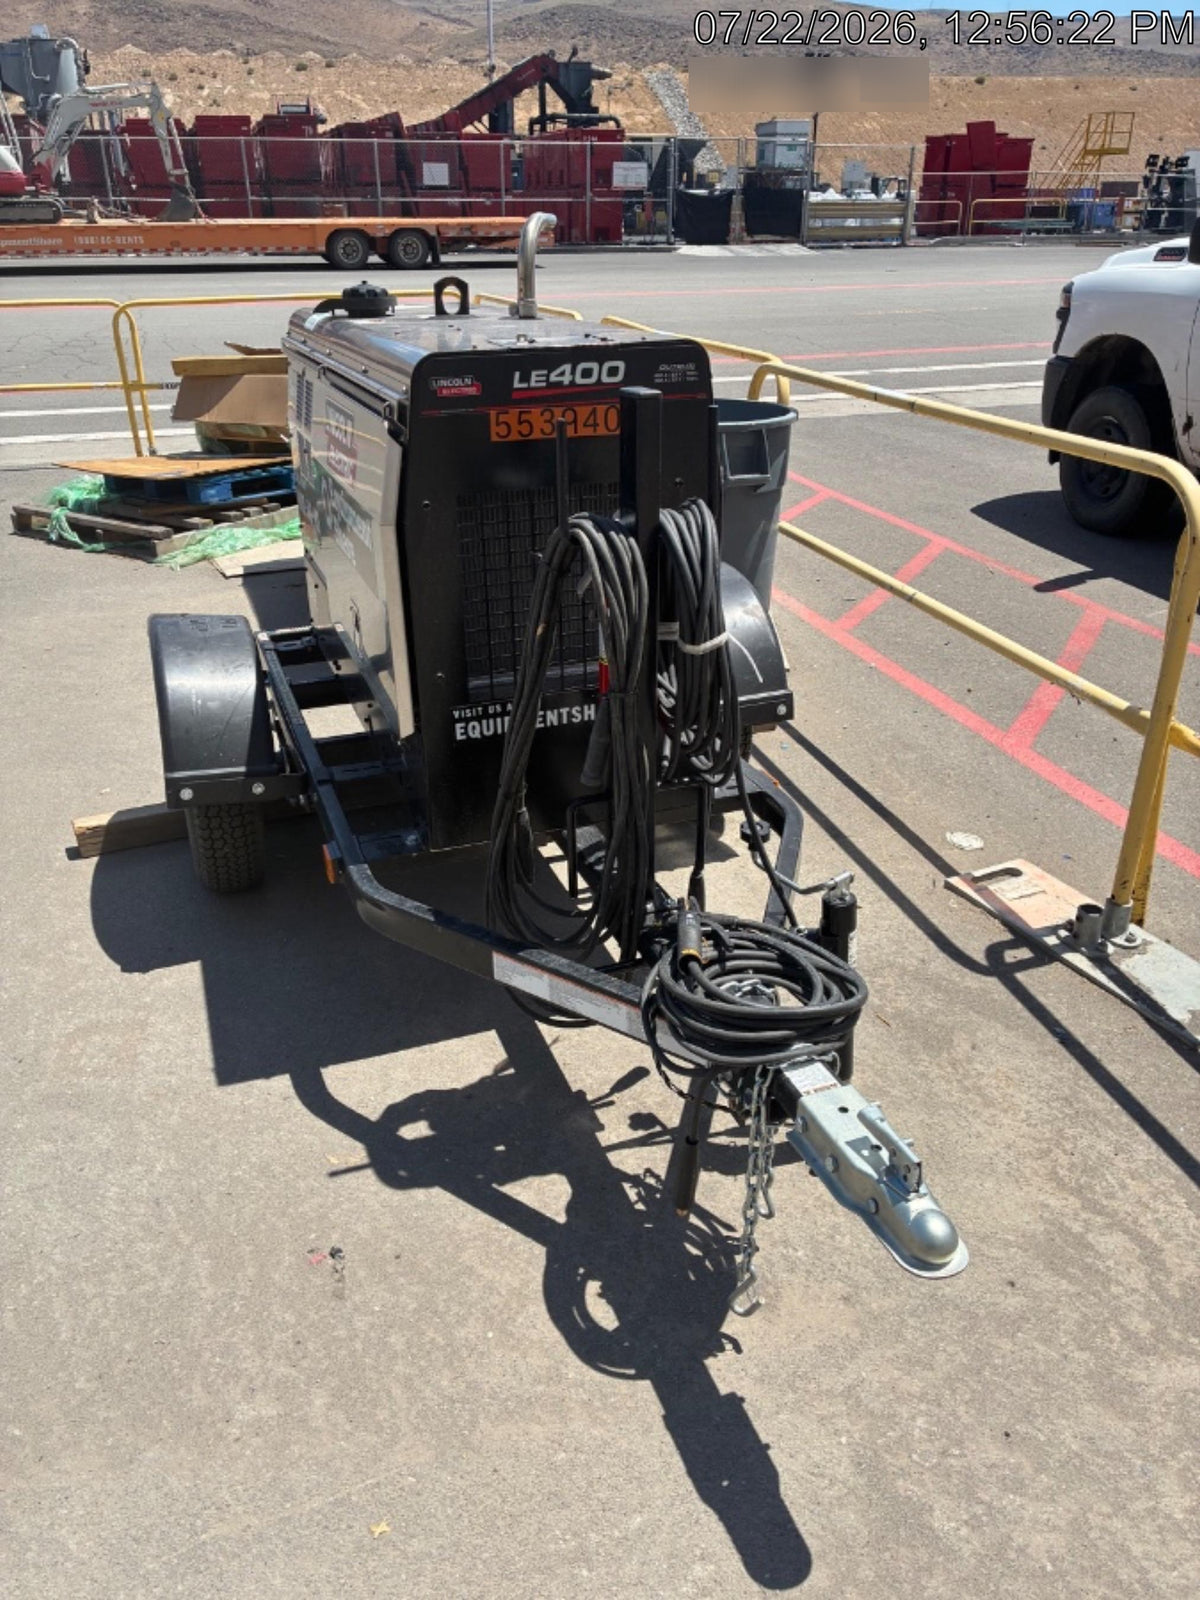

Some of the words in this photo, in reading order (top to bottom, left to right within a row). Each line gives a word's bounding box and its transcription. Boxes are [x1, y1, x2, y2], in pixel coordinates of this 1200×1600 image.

[431, 377, 472, 387] LINCOLN
[512, 360, 626, 389] LE400
[495, 403, 621, 439] 553940
[452, 707, 483, 719] VISIT
[488, 704, 502, 714] US
[506, 702, 513, 712] A
[455, 704, 597, 741] EQUIENTSH
